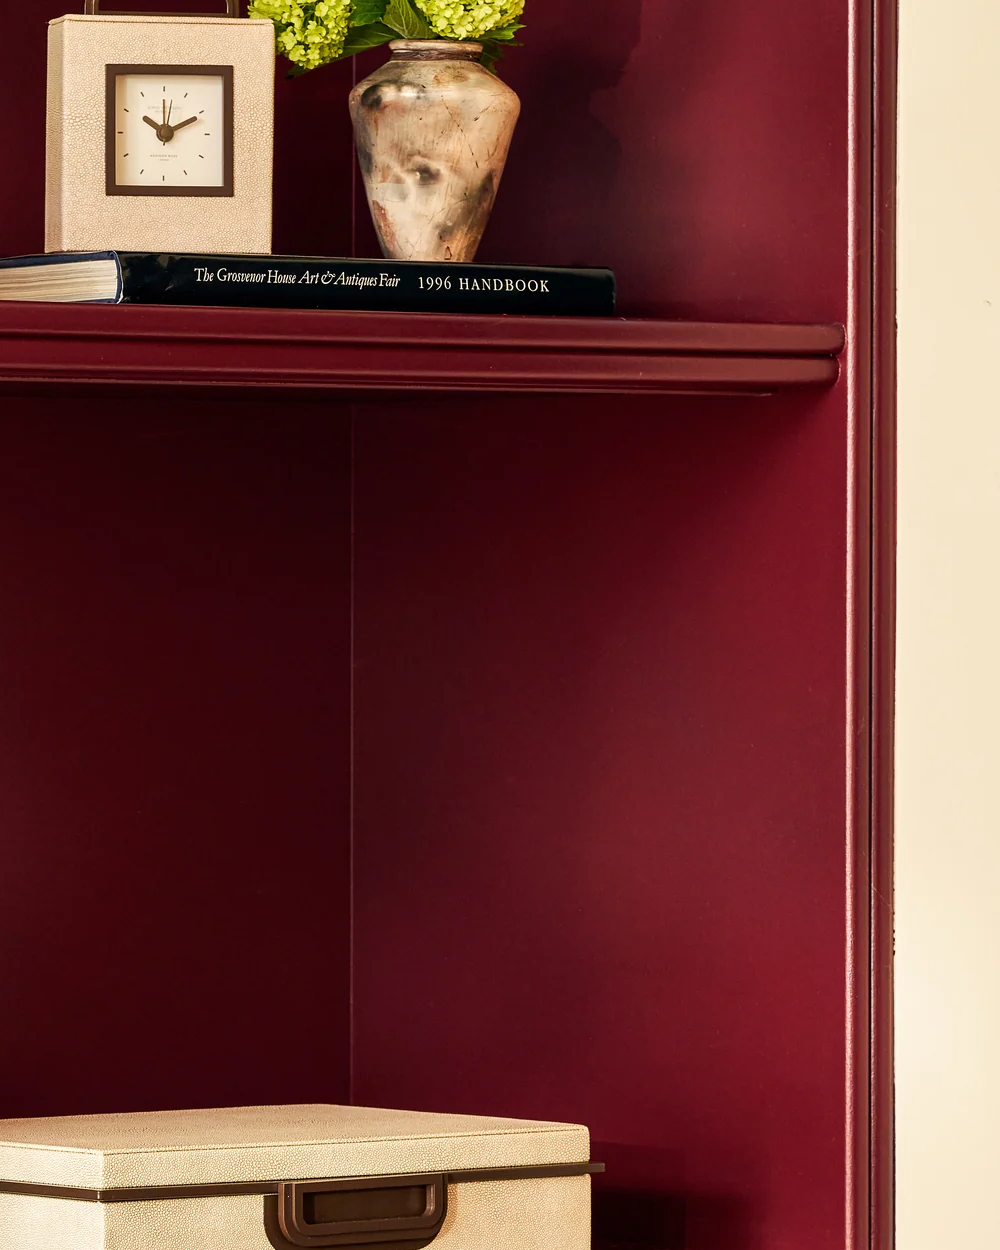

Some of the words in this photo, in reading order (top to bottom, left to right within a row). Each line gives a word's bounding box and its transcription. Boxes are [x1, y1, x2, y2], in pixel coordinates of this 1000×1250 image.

[194, 267, 214, 282] The
[216, 267, 266, 284] Grosvenor
[267, 269, 296, 285] House
[298, 270, 319, 285] Art
[320, 270, 335, 285] &
[334, 271, 378, 290] Antiques
[379, 272, 401, 288] Fair
[418, 276, 451, 291] 1996
[459, 277, 550, 293] HANDBOOK
